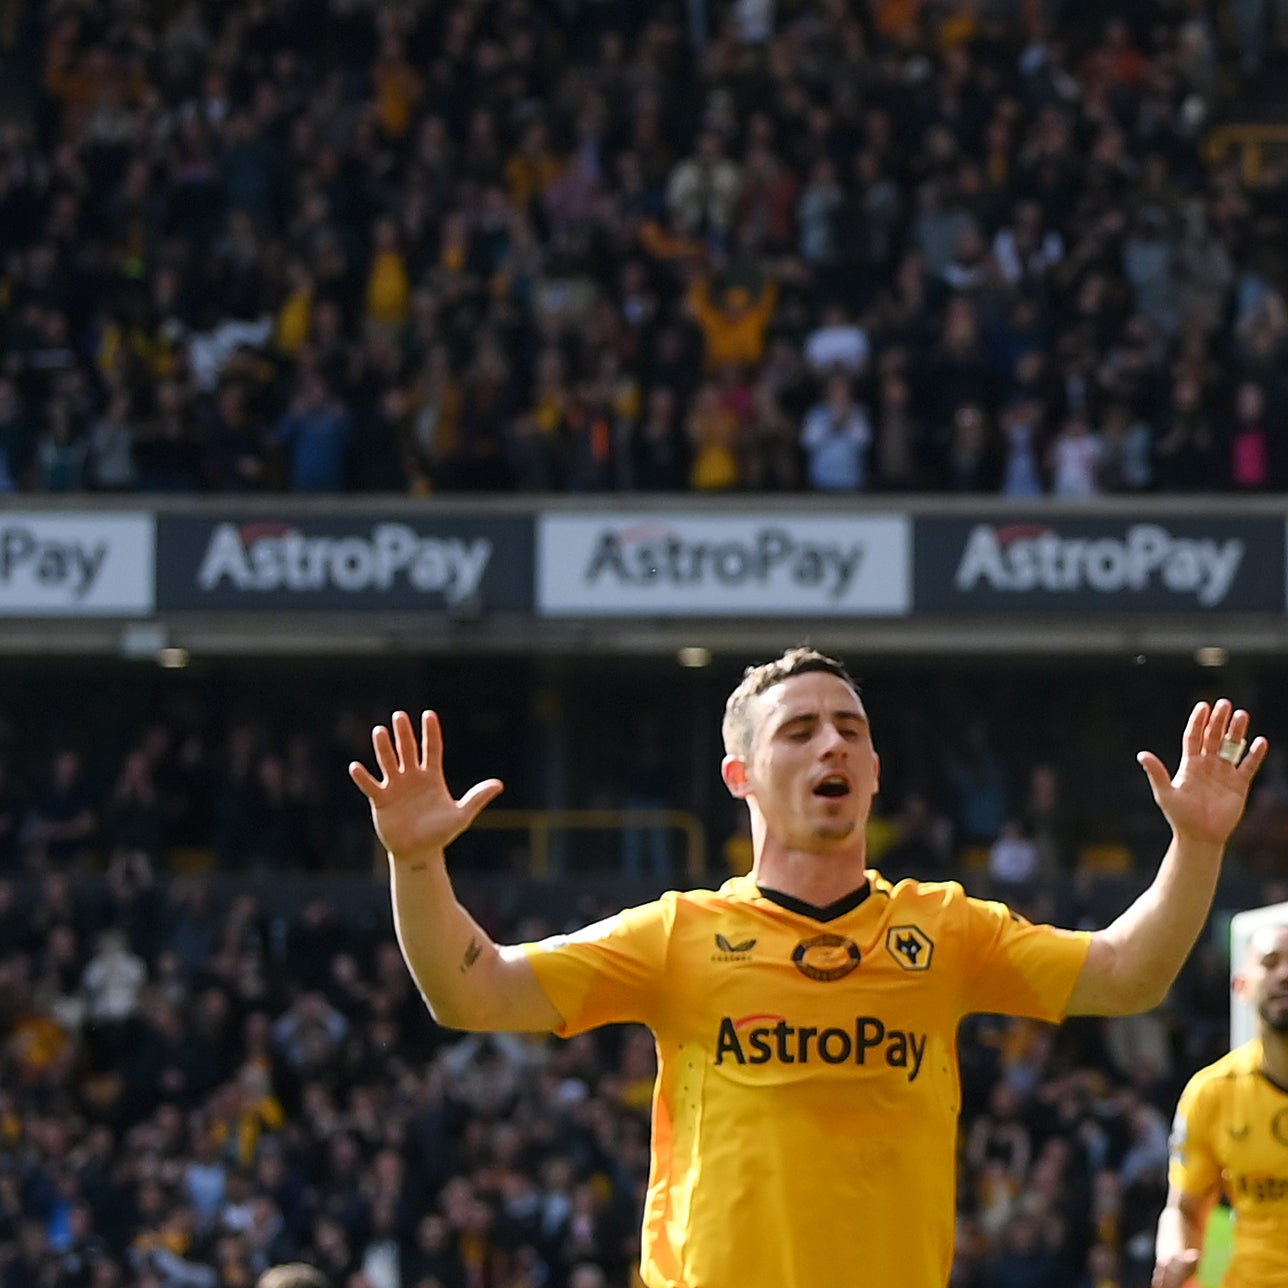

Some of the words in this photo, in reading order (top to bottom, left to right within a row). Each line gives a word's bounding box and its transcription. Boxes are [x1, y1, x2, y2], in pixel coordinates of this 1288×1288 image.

[0, 527, 108, 598] Pay
[199, 522, 492, 605] AstroPay
[585, 525, 865, 600] AstroPay
[956, 523, 1243, 605] AstroPay
[714, 1016, 926, 1082] AstroPay
